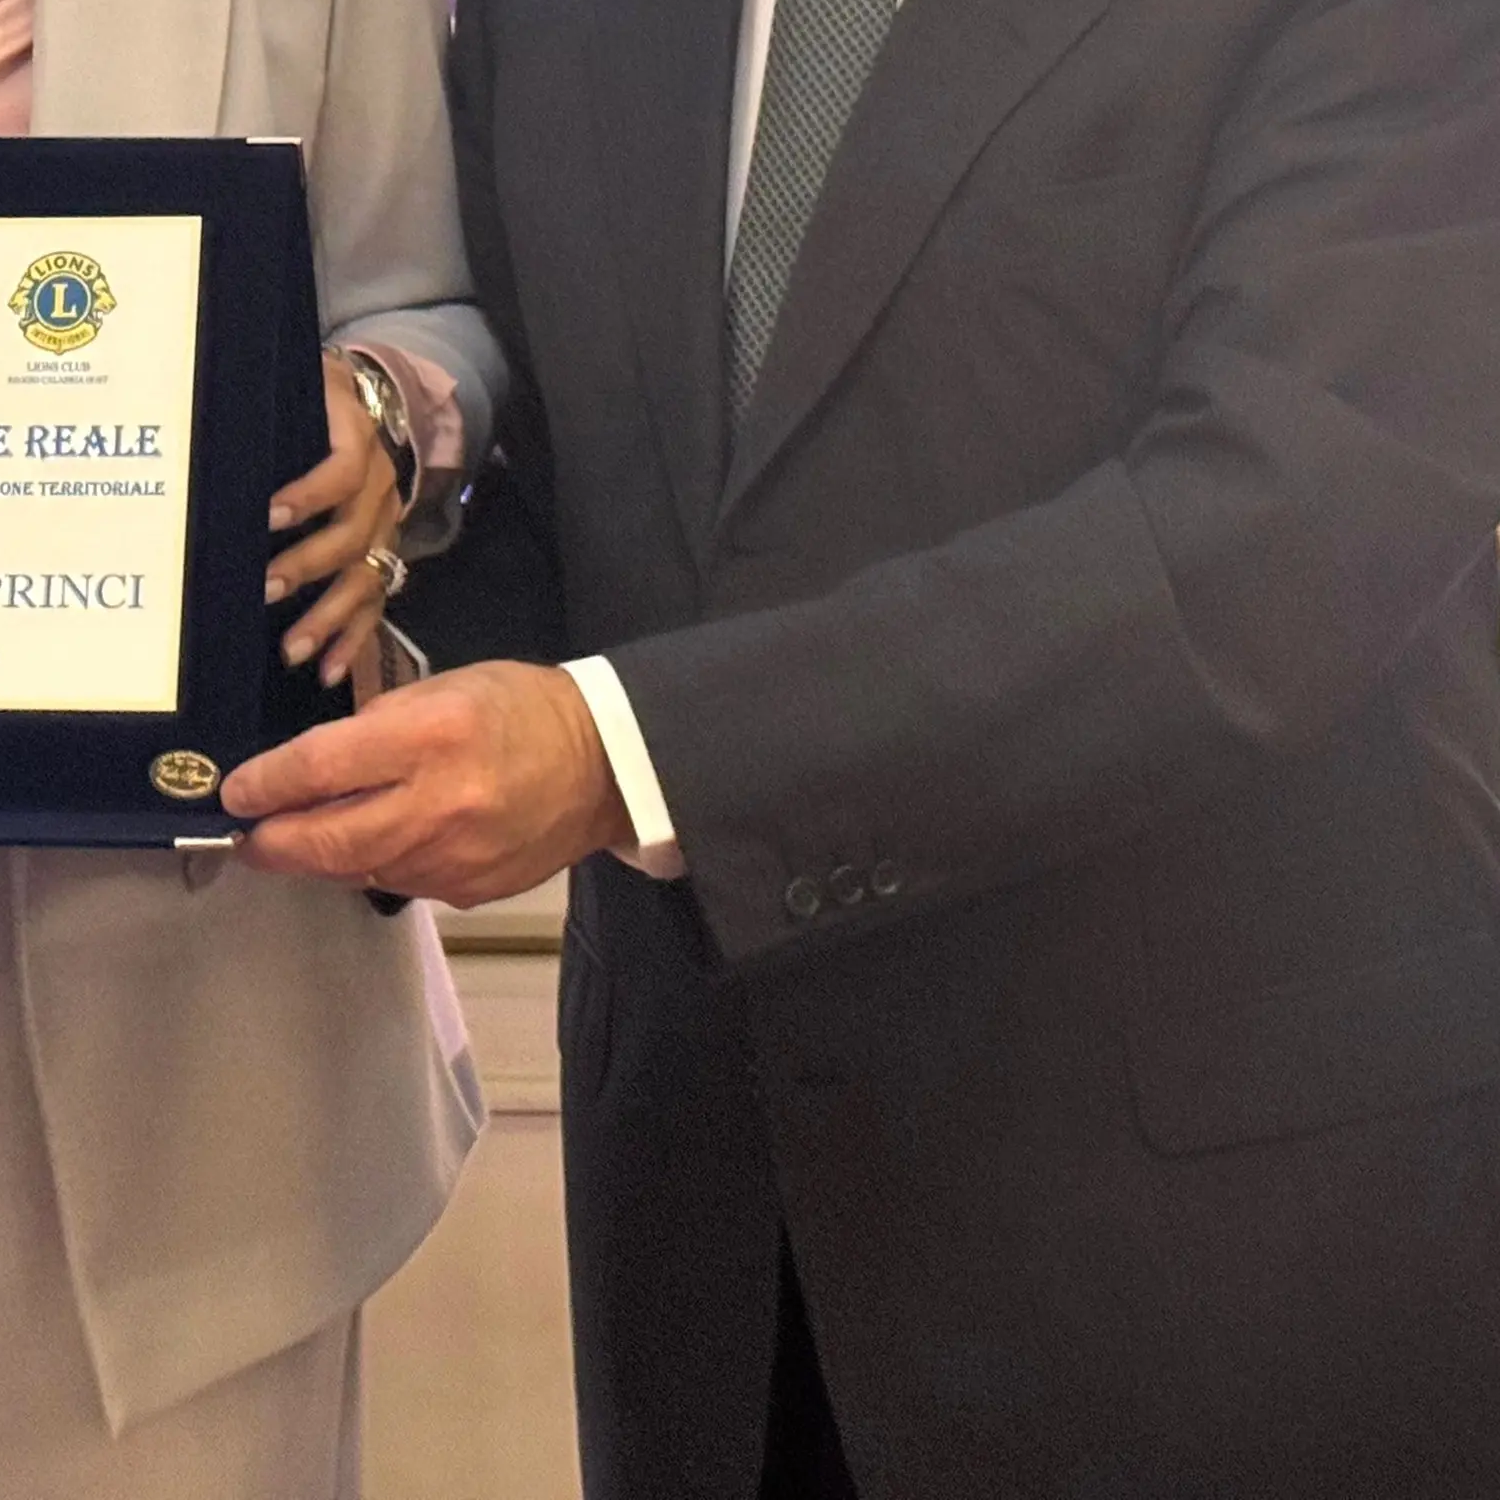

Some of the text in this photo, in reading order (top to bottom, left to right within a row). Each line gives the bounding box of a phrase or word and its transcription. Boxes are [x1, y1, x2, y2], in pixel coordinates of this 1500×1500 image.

[34, 255, 95, 277] LIONS
[50, 283, 78, 318] L
[25, 425, 163, 461] REALE
[38, 480, 166, 497] TERRITORIALE
